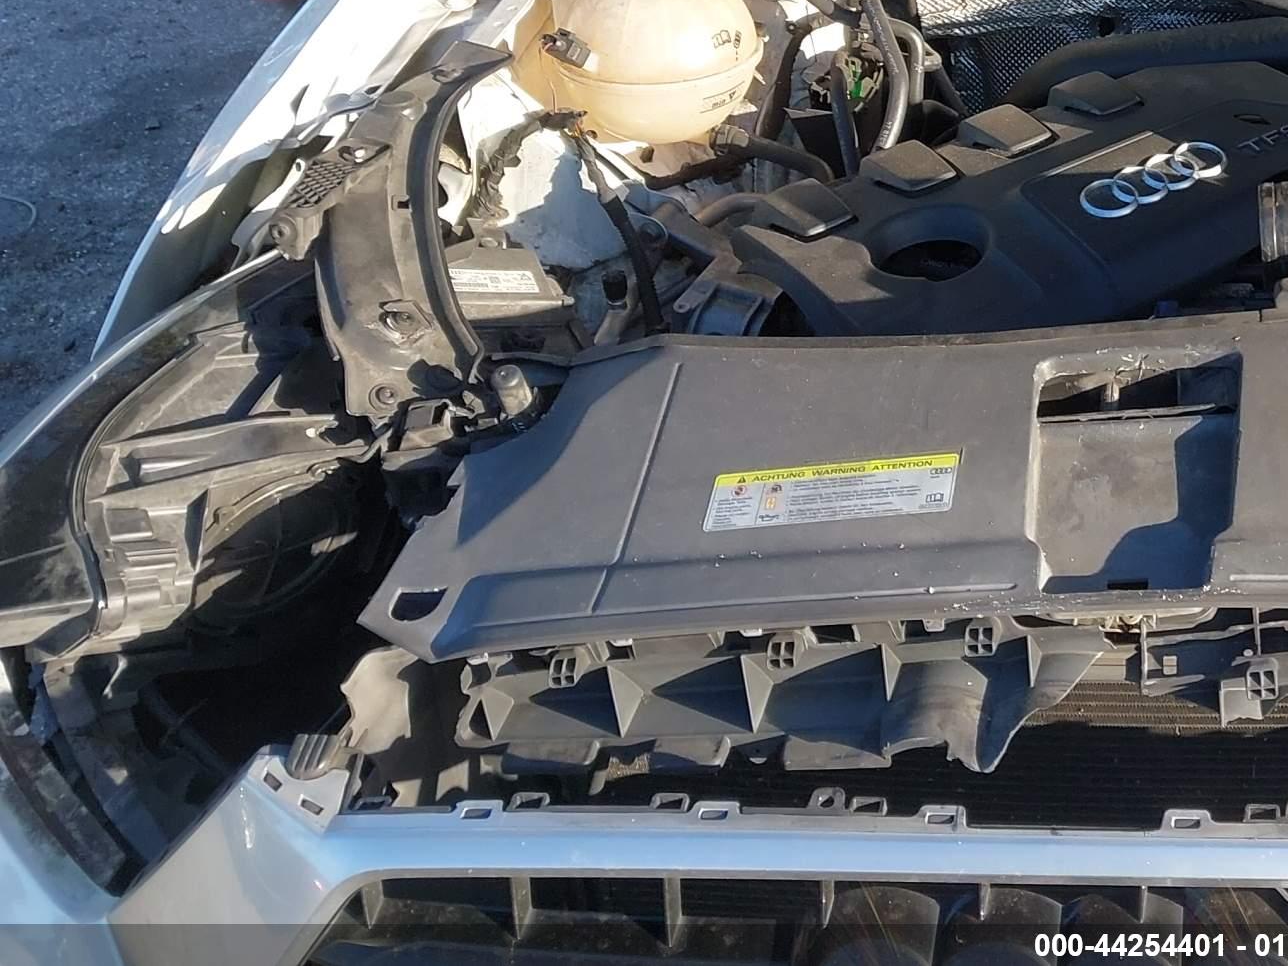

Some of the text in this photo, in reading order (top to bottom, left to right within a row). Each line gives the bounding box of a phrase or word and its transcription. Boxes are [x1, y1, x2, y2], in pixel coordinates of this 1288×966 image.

[752, 459, 933, 483] ACHTUNG WARNING ATTENTION
